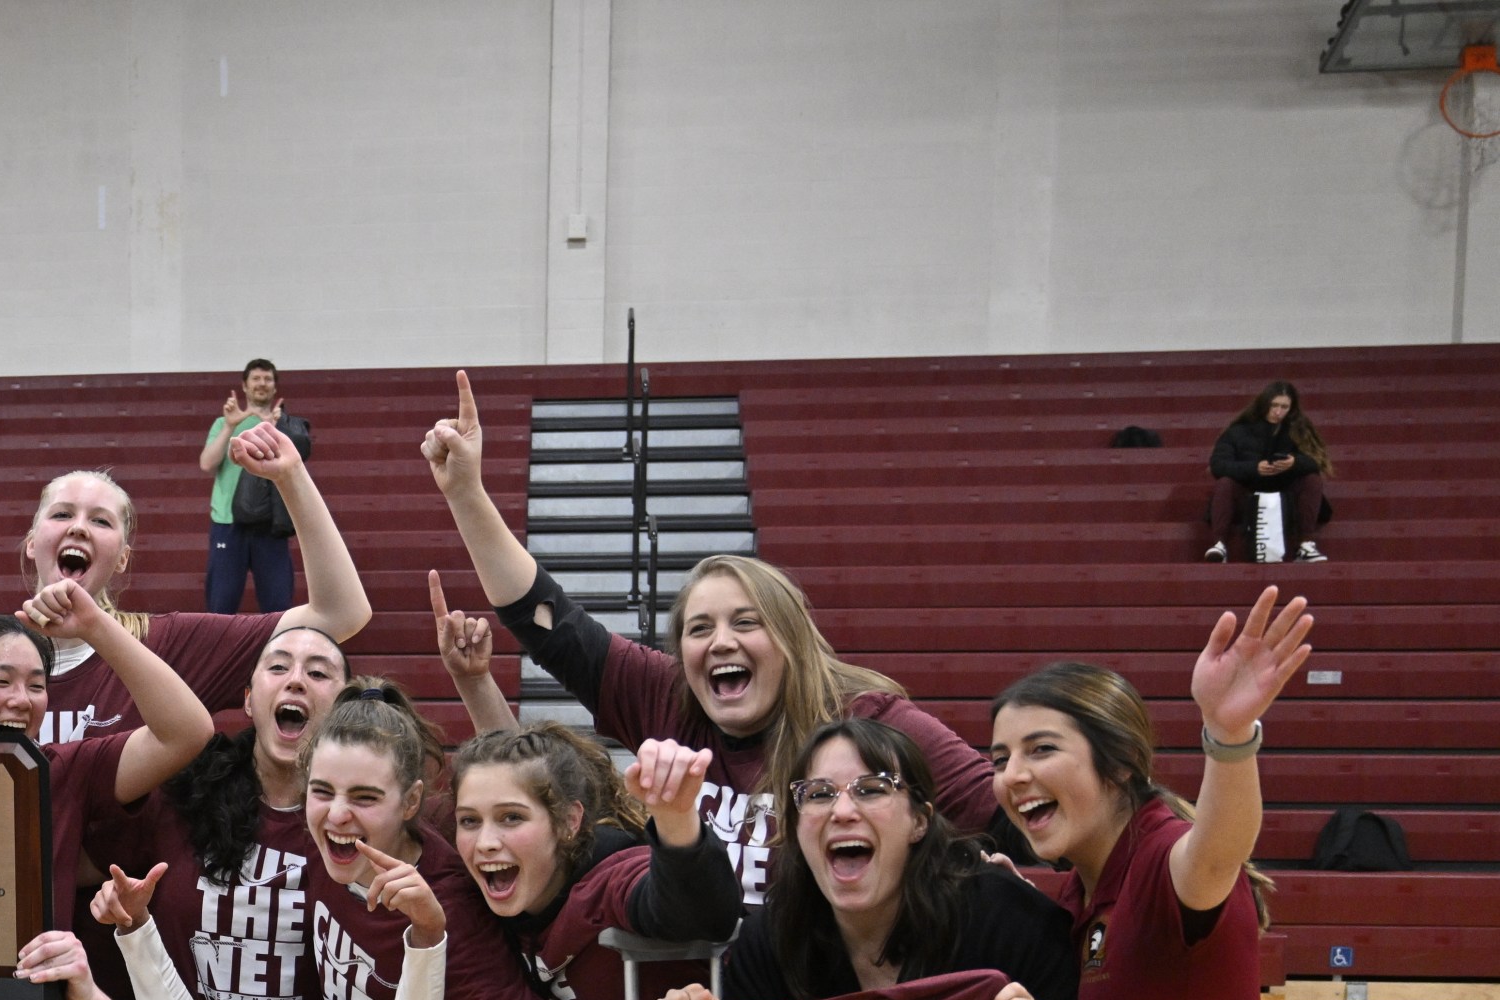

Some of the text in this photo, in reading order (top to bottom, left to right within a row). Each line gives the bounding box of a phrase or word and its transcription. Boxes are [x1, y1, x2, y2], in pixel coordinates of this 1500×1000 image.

[204, 843, 307, 889] UT
[197, 875, 306, 943] THE
[194, 931, 305, 997] NET
[313, 900, 375, 994] CUT
